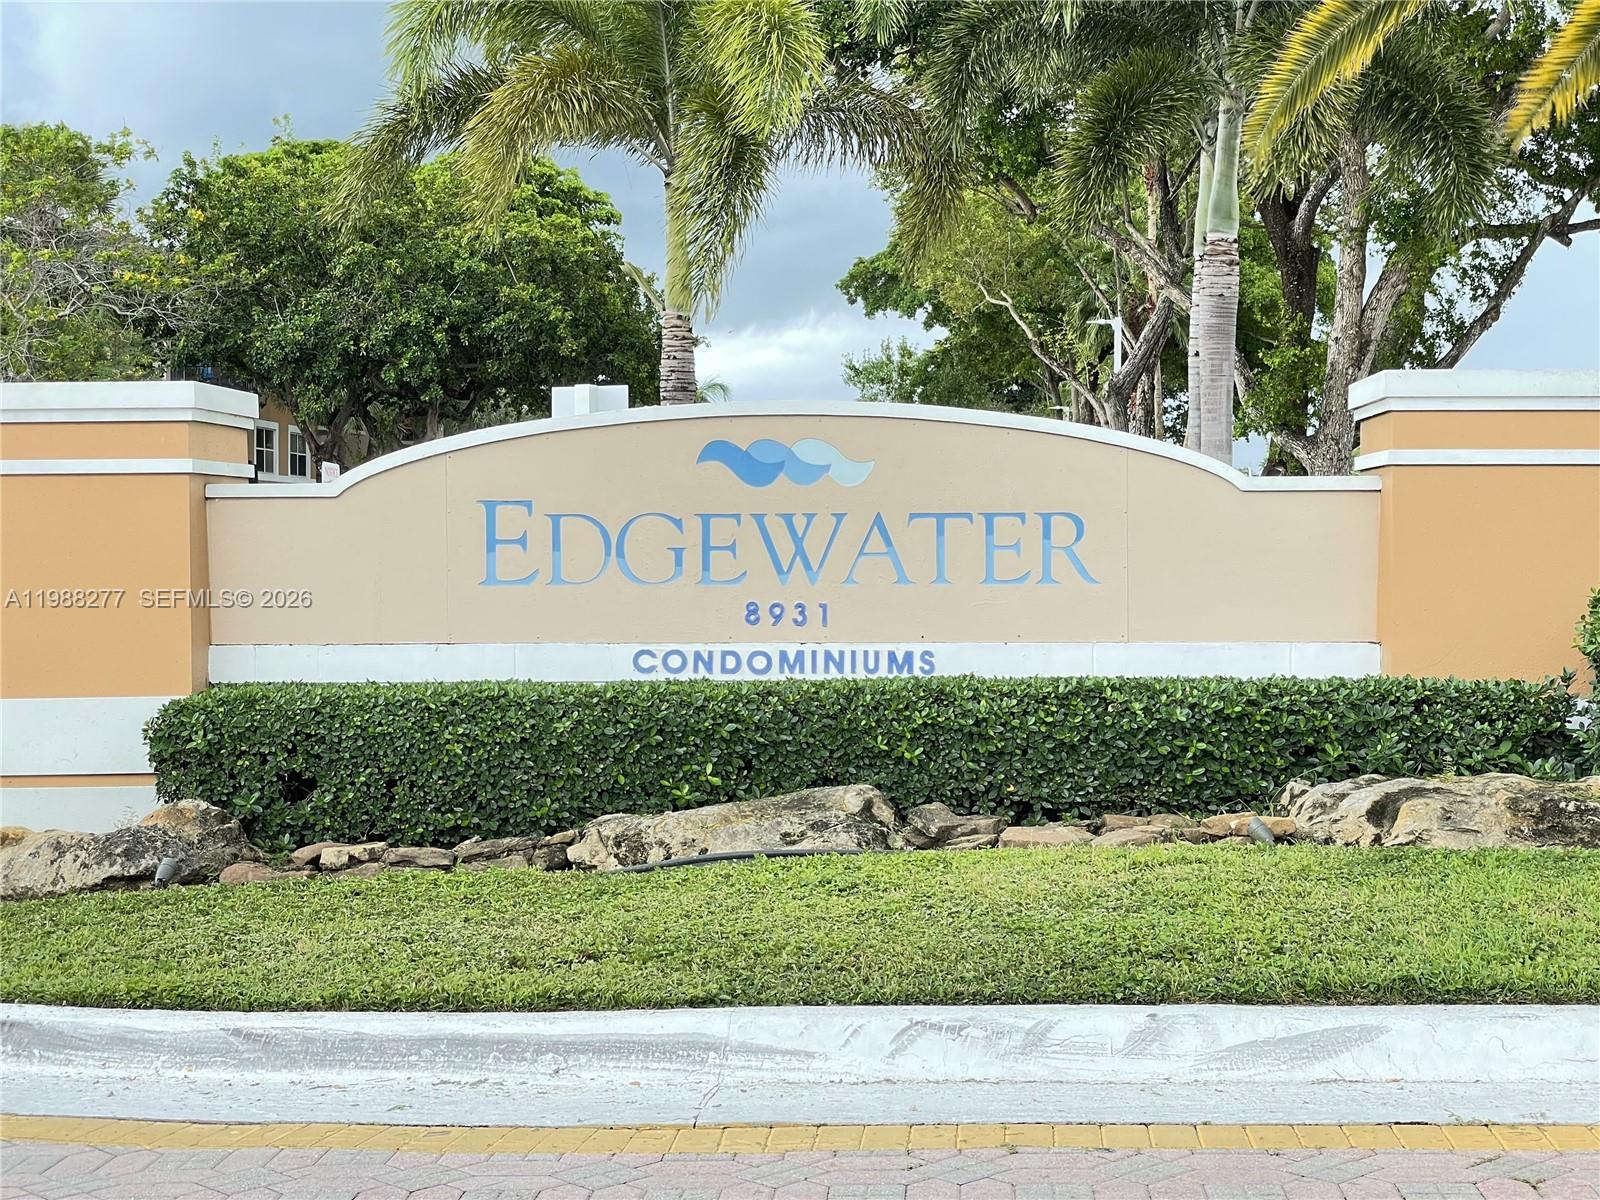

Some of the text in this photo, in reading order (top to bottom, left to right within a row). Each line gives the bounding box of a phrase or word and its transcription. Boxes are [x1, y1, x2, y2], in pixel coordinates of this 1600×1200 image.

[477, 499, 1101, 587] EDGEWATER
[744, 601, 831, 627] 8931
[631, 648, 937, 676] CONDOMINIUMS
